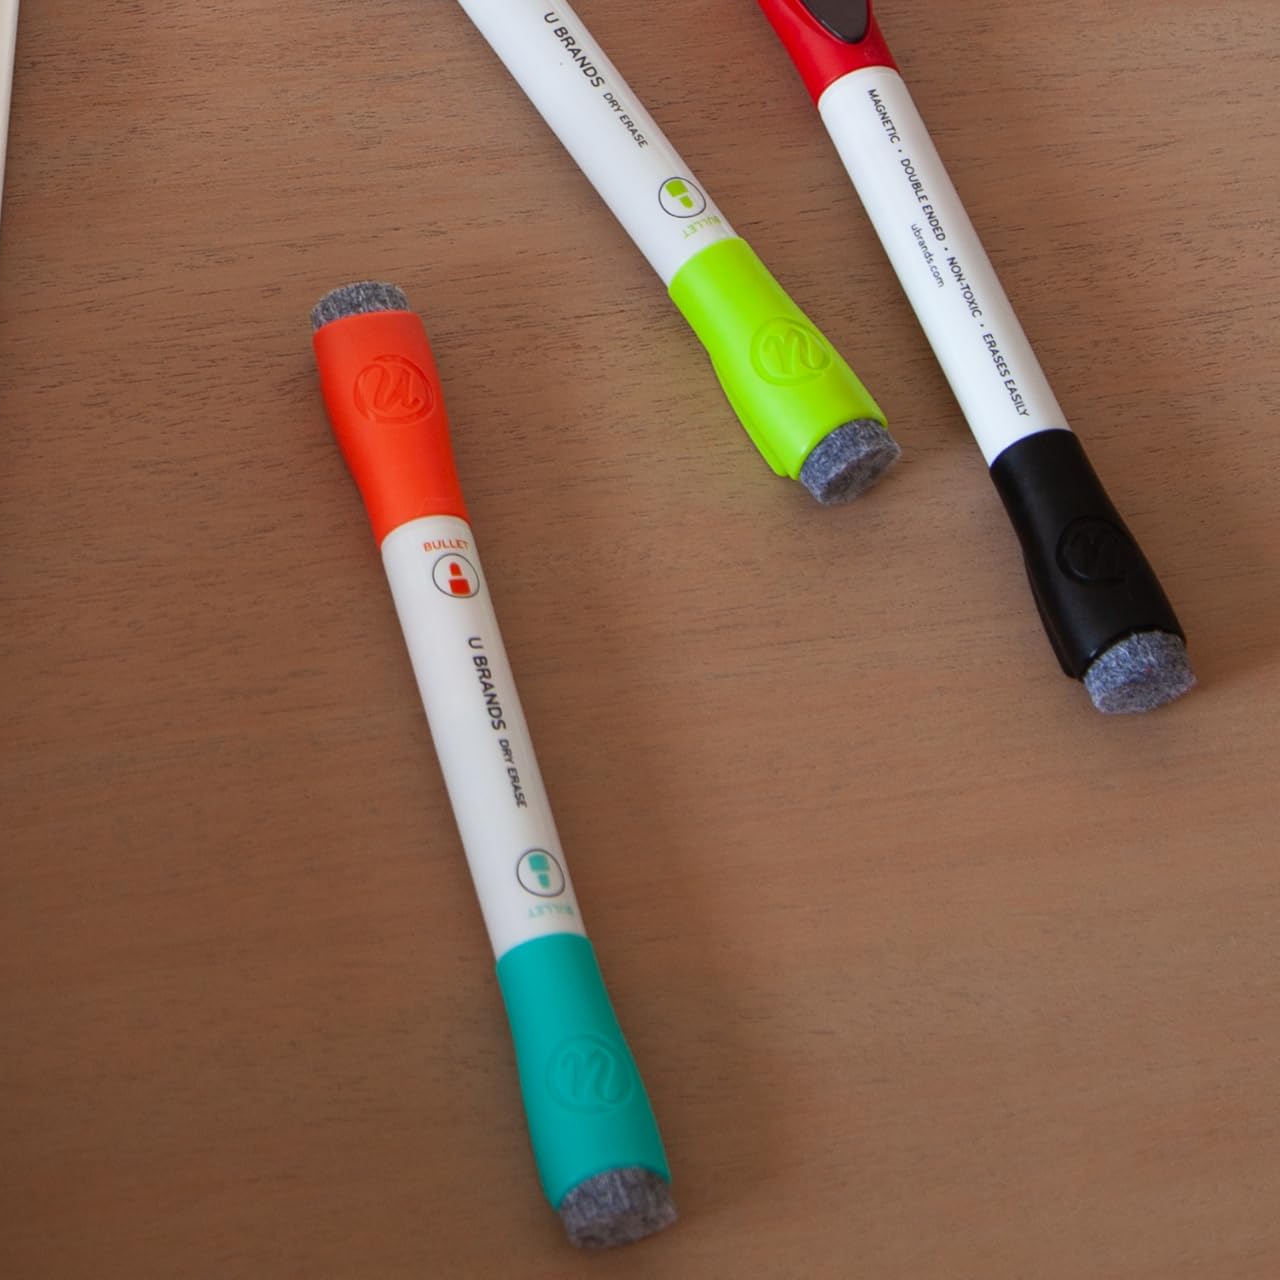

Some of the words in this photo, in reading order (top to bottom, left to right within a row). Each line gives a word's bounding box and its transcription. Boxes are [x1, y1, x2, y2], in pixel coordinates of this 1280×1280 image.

[544, 11, 559, 24] U
[553, 26, 605, 88] BRANDS
[603, 92, 623, 113] DRY
[619, 114, 648, 148] ERASE
[867, 88, 901, 144] MAGNETIC
[900, 158, 928, 203] DOUBLE
[922, 204, 946, 242] ENDED
[946, 256, 983, 319] NON-TOXIC
[982, 333, 1011, 378] ERASES
[1004, 378, 1030, 417] EASILY
[910, 223, 945, 288] ubrands.com
[423, 538, 469, 552] BULLET
[468, 636, 484, 649] U
[472, 655, 507, 731] BRANDS
[498, 738, 515, 763] DRY
[507, 767, 527, 809] ERASE
